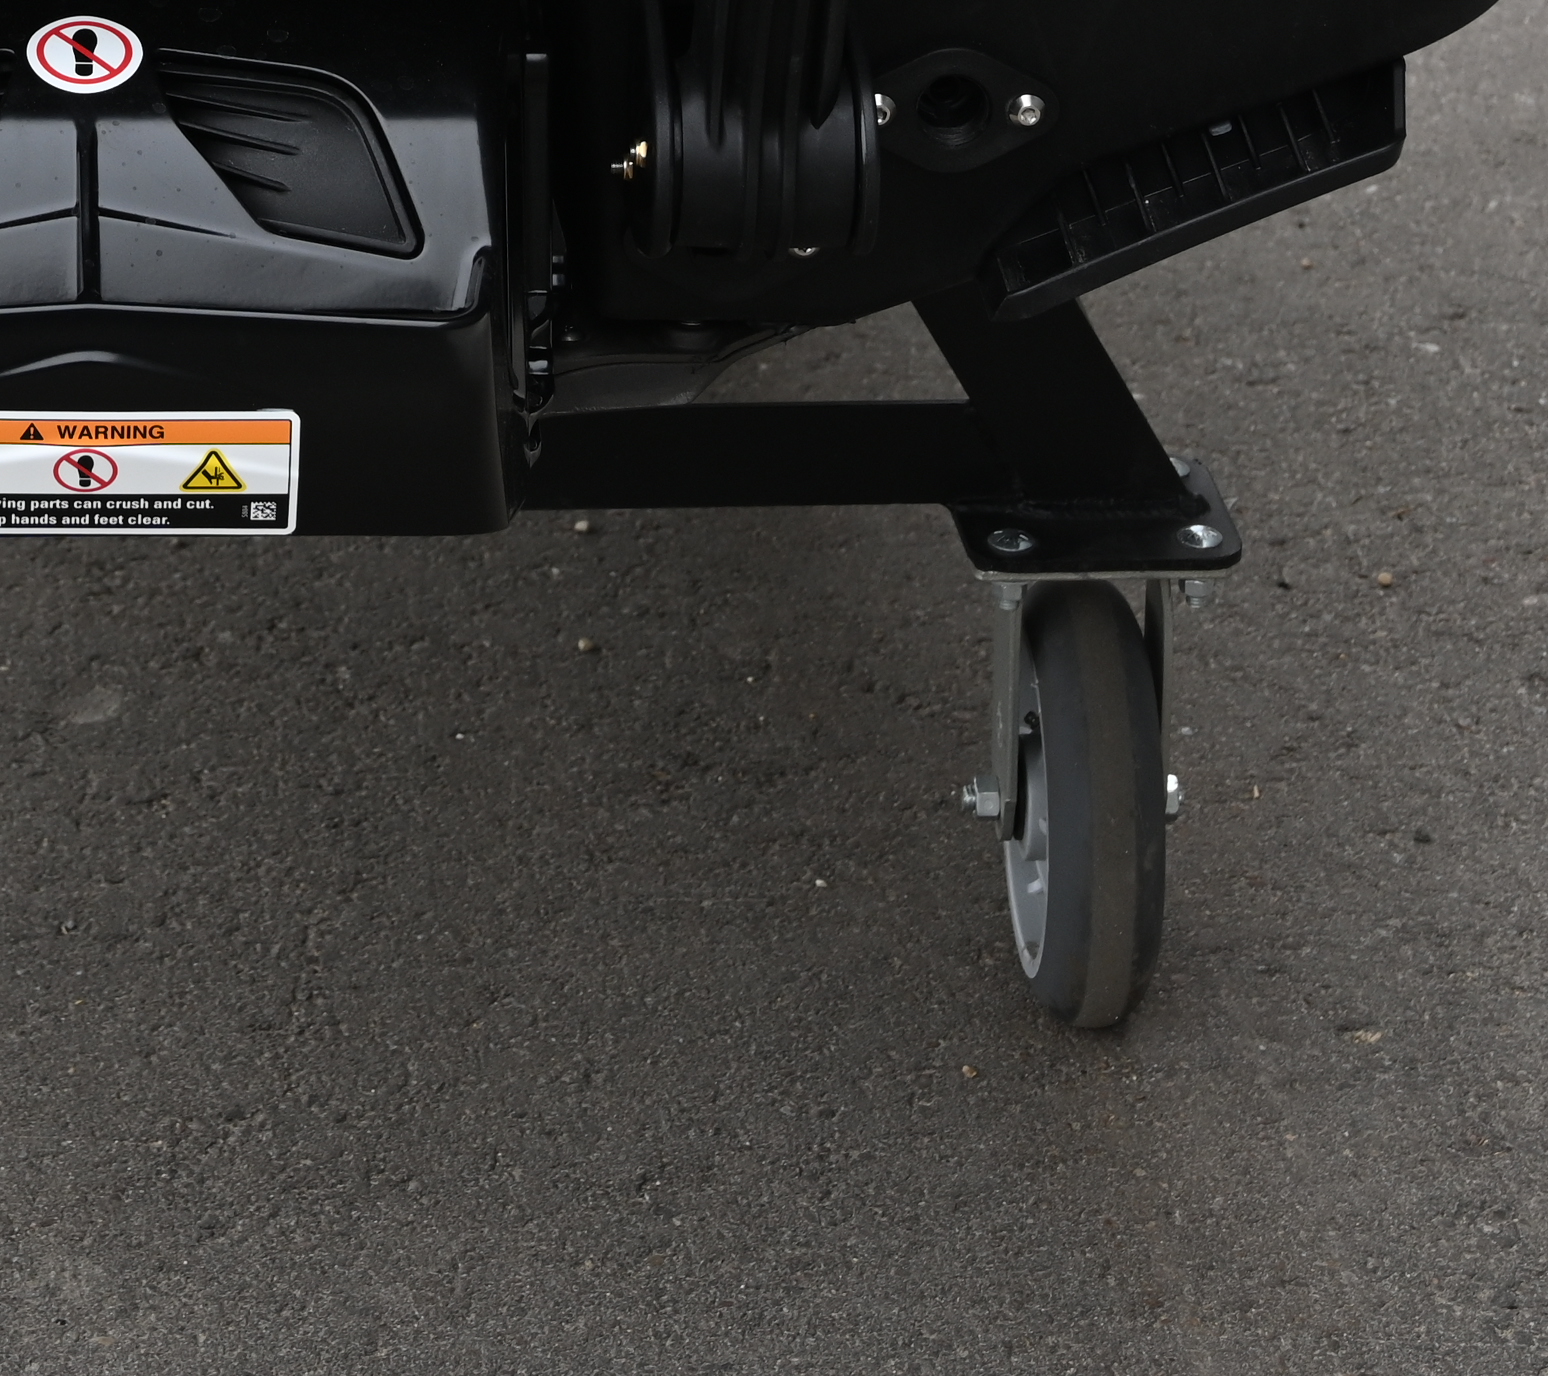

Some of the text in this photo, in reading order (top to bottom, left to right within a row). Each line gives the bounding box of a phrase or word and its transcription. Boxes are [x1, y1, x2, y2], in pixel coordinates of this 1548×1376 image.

[57, 425, 165, 439] WARNING
[30, 498, 69, 511] parts
[73, 500, 101, 510] can
[106, 498, 149, 510] crush
[153, 498, 181, 510] and
[186, 499, 214, 510] cut.
[11, 514, 57, 525] hands
[62, 514, 90, 525] and
[94, 515, 124, 525] feet
[128, 515, 170, 525] clear.
